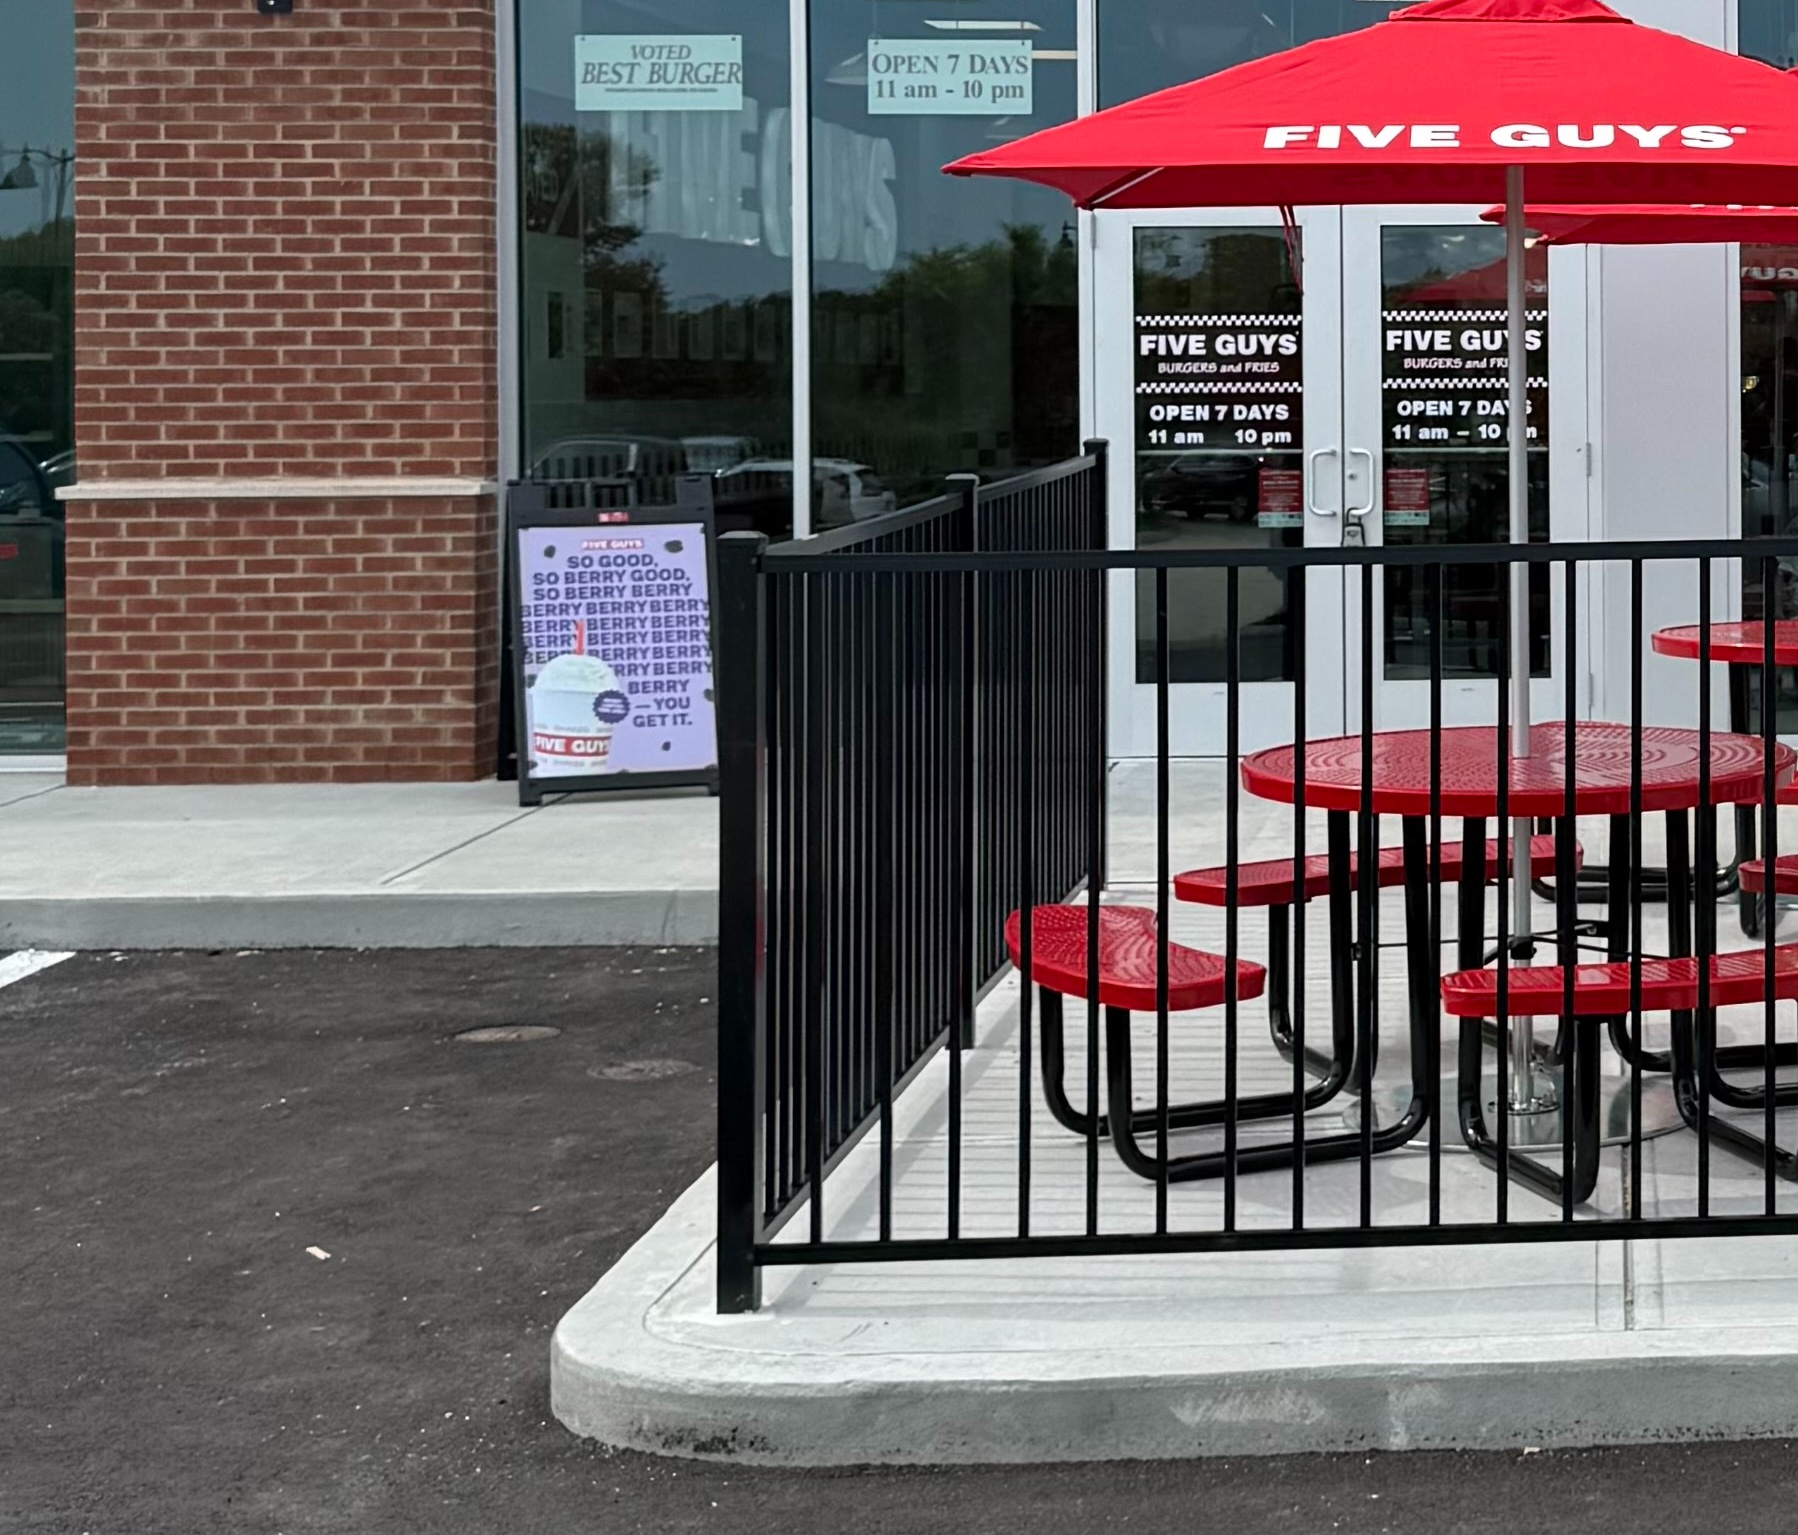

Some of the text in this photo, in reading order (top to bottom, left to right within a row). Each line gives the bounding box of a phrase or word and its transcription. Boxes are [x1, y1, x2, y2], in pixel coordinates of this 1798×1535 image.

[631, 44, 692, 60] VOTED
[872, 53, 1029, 74] OPEN 7 DAYS
[581, 62, 742, 84] BEST BURGER
[876, 79, 896, 98] 11
[904, 84, 937, 98] am
[963, 80, 983, 98] 10
[991, 84, 1025, 103] pm
[1263, 124, 1735, 149] FIVE GUYS
[1140, 334, 1298, 356] FIVE GUYS
[1386, 329, 1542, 351] FIVE GUS
[1158, 362, 1280, 373] BURGERS and FRIES
[1404, 358, 1509, 369] BURGERS and FRI
[1149, 405, 1289, 421] OPEN 7 DAYS
[1397, 400, 1532, 416] OPEN 7 DA
[1148, 429, 1292, 445] 11 am 10 pm
[1392, 424, 1411, 440] 11
[1418, 428, 1449, 440] am
[1478, 424, 1501, 439] 10
[567, 555, 594, 568] SO
[533, 572, 560, 585] SO
[564, 570, 626, 584] BERRY
[533, 582, 693, 601] SO BERRY BERRY
[520, 598, 709, 618] BERRY BERRY BERRY
[586, 616, 648, 631] BERRY
[523, 634, 577, 649] BERR
[587, 632, 649, 646] BERRY
[608, 661, 712, 677] RRY BERRY
[628, 679, 690, 694] BERRY
[633, 714, 693, 727] GET IT.
